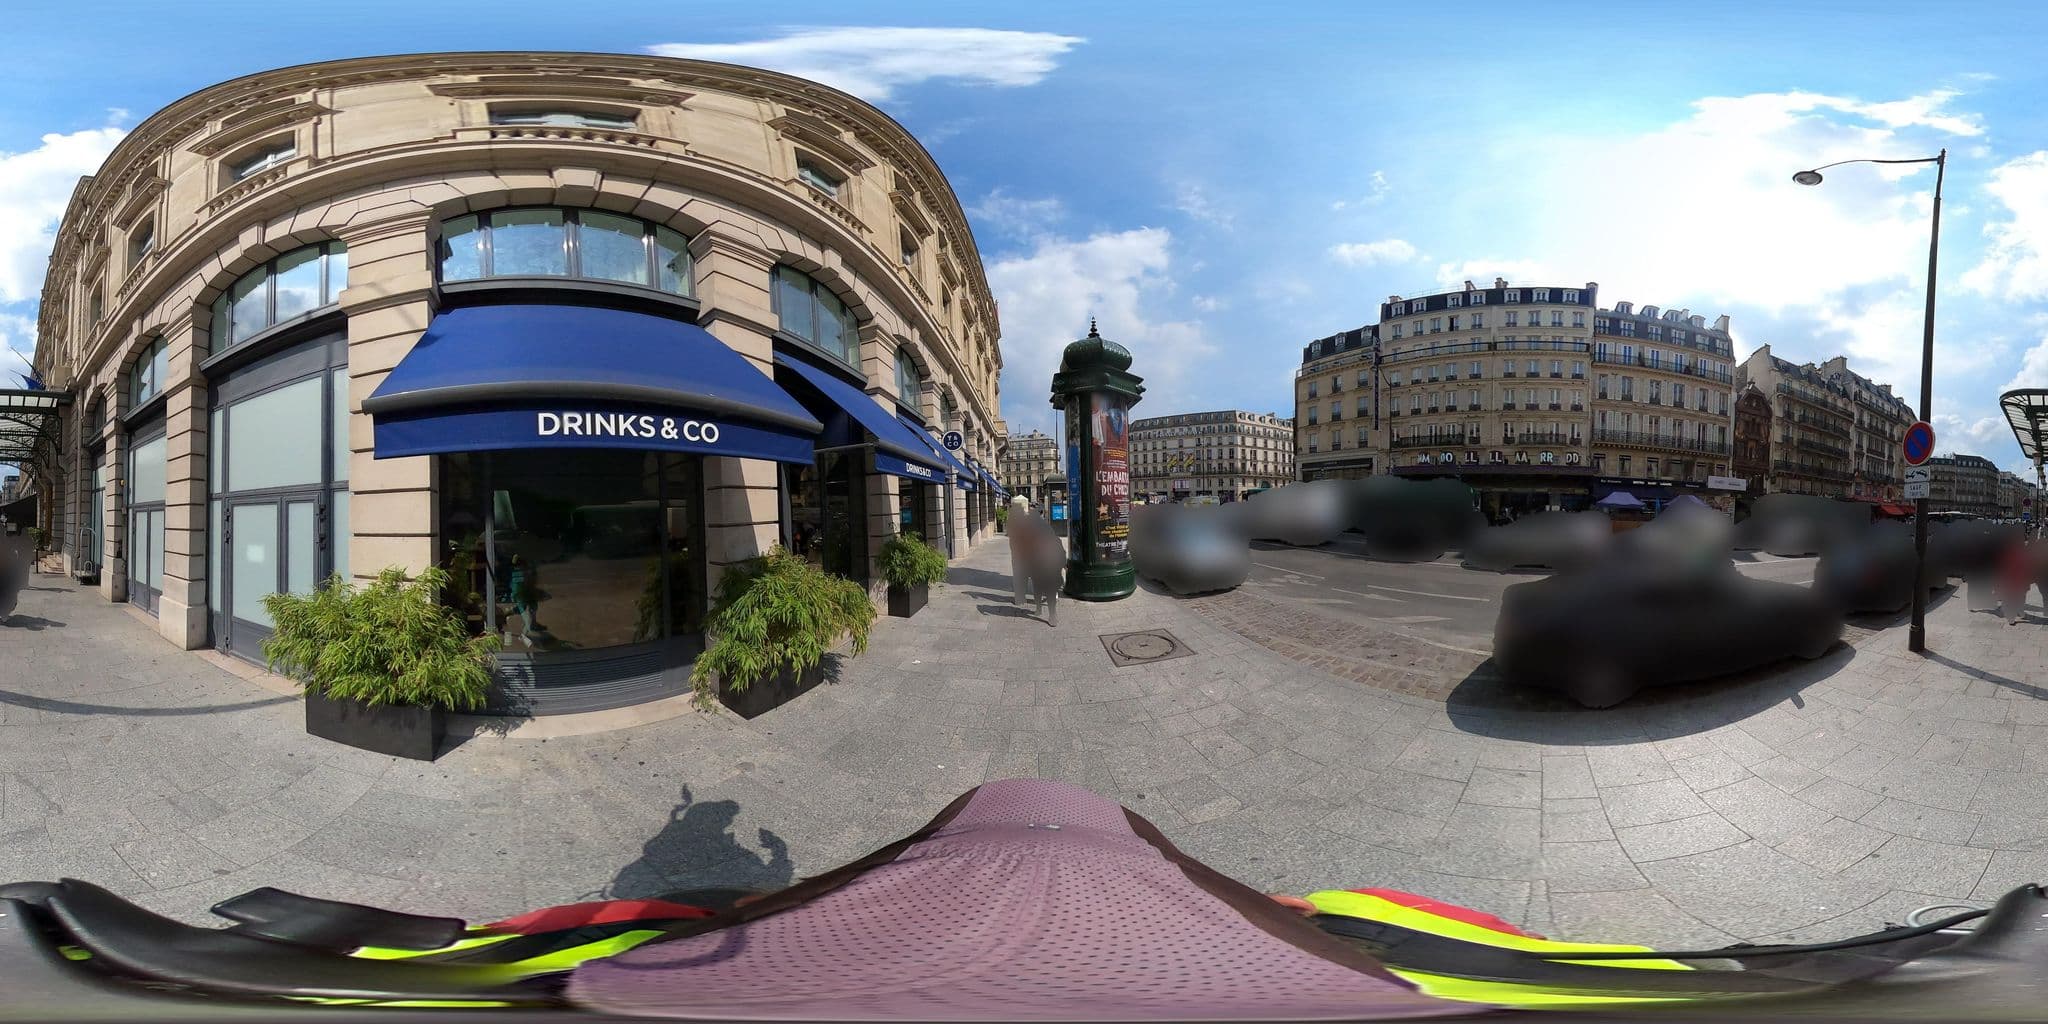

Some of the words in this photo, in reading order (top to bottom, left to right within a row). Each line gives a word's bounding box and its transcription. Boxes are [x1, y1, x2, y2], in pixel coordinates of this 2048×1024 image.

[538, 412, 656, 438] DRINKS
[661, 418, 678, 440] &
[683, 420, 720, 443] CO
[1102, 484, 1112, 496] DU
